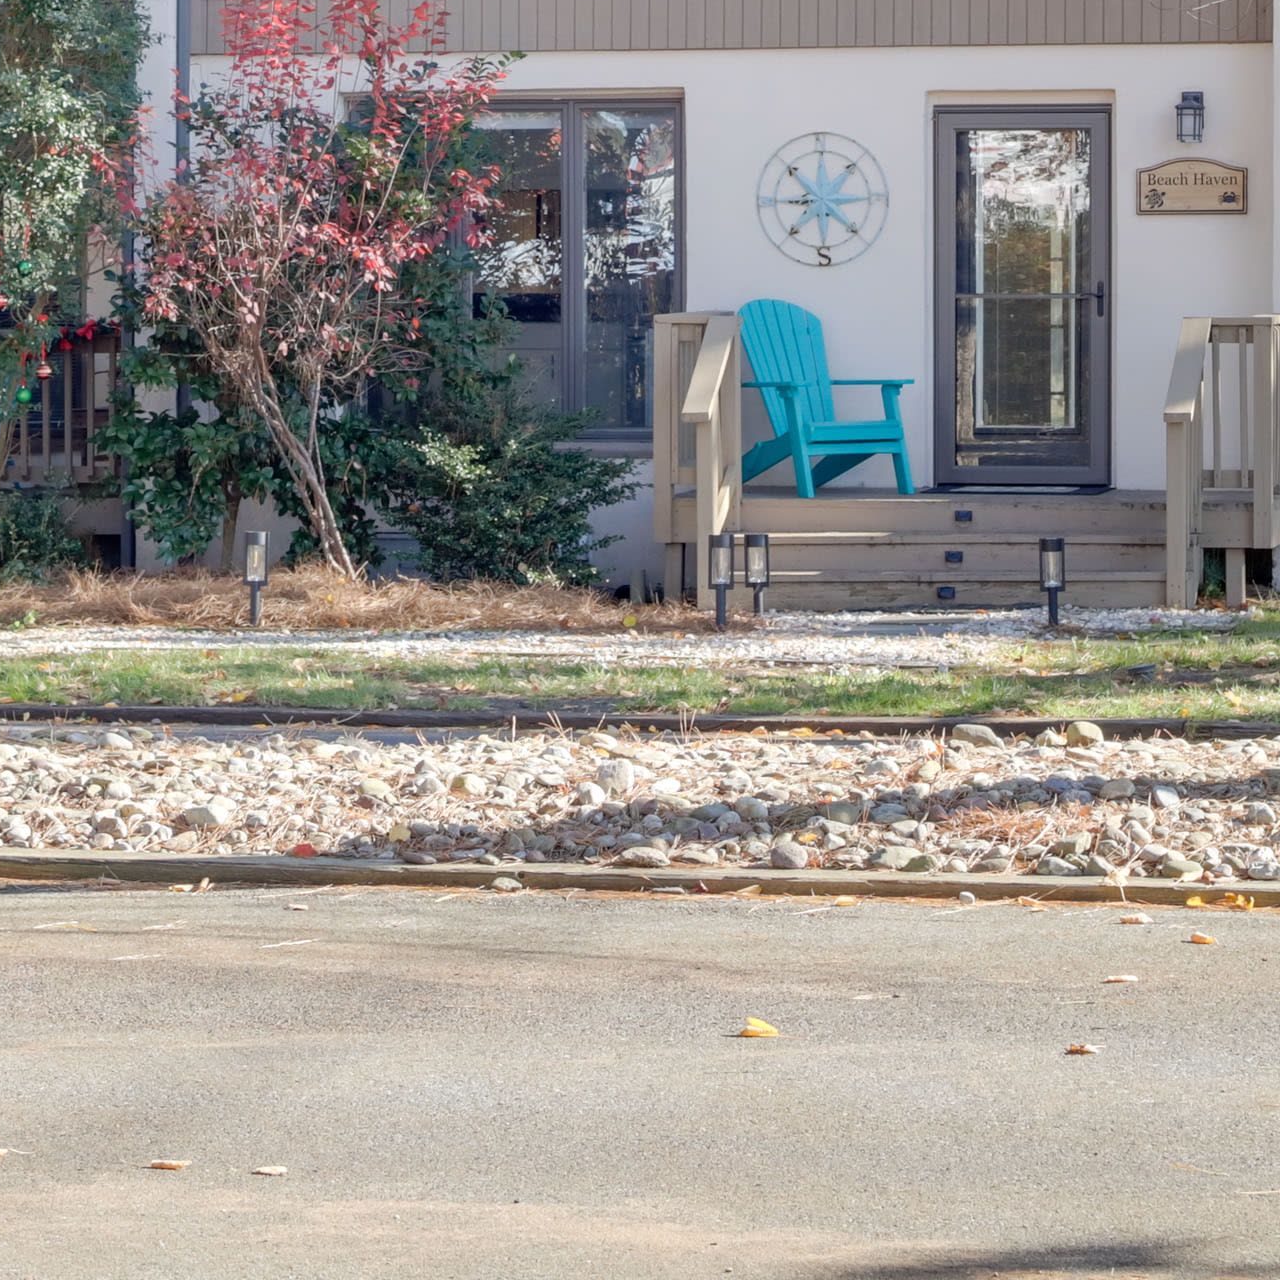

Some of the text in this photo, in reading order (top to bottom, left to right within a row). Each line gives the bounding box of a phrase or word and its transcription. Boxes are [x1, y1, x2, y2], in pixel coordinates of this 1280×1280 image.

[1147, 172, 1238, 186] Beach Haven
[816, 246, 831, 267] S
